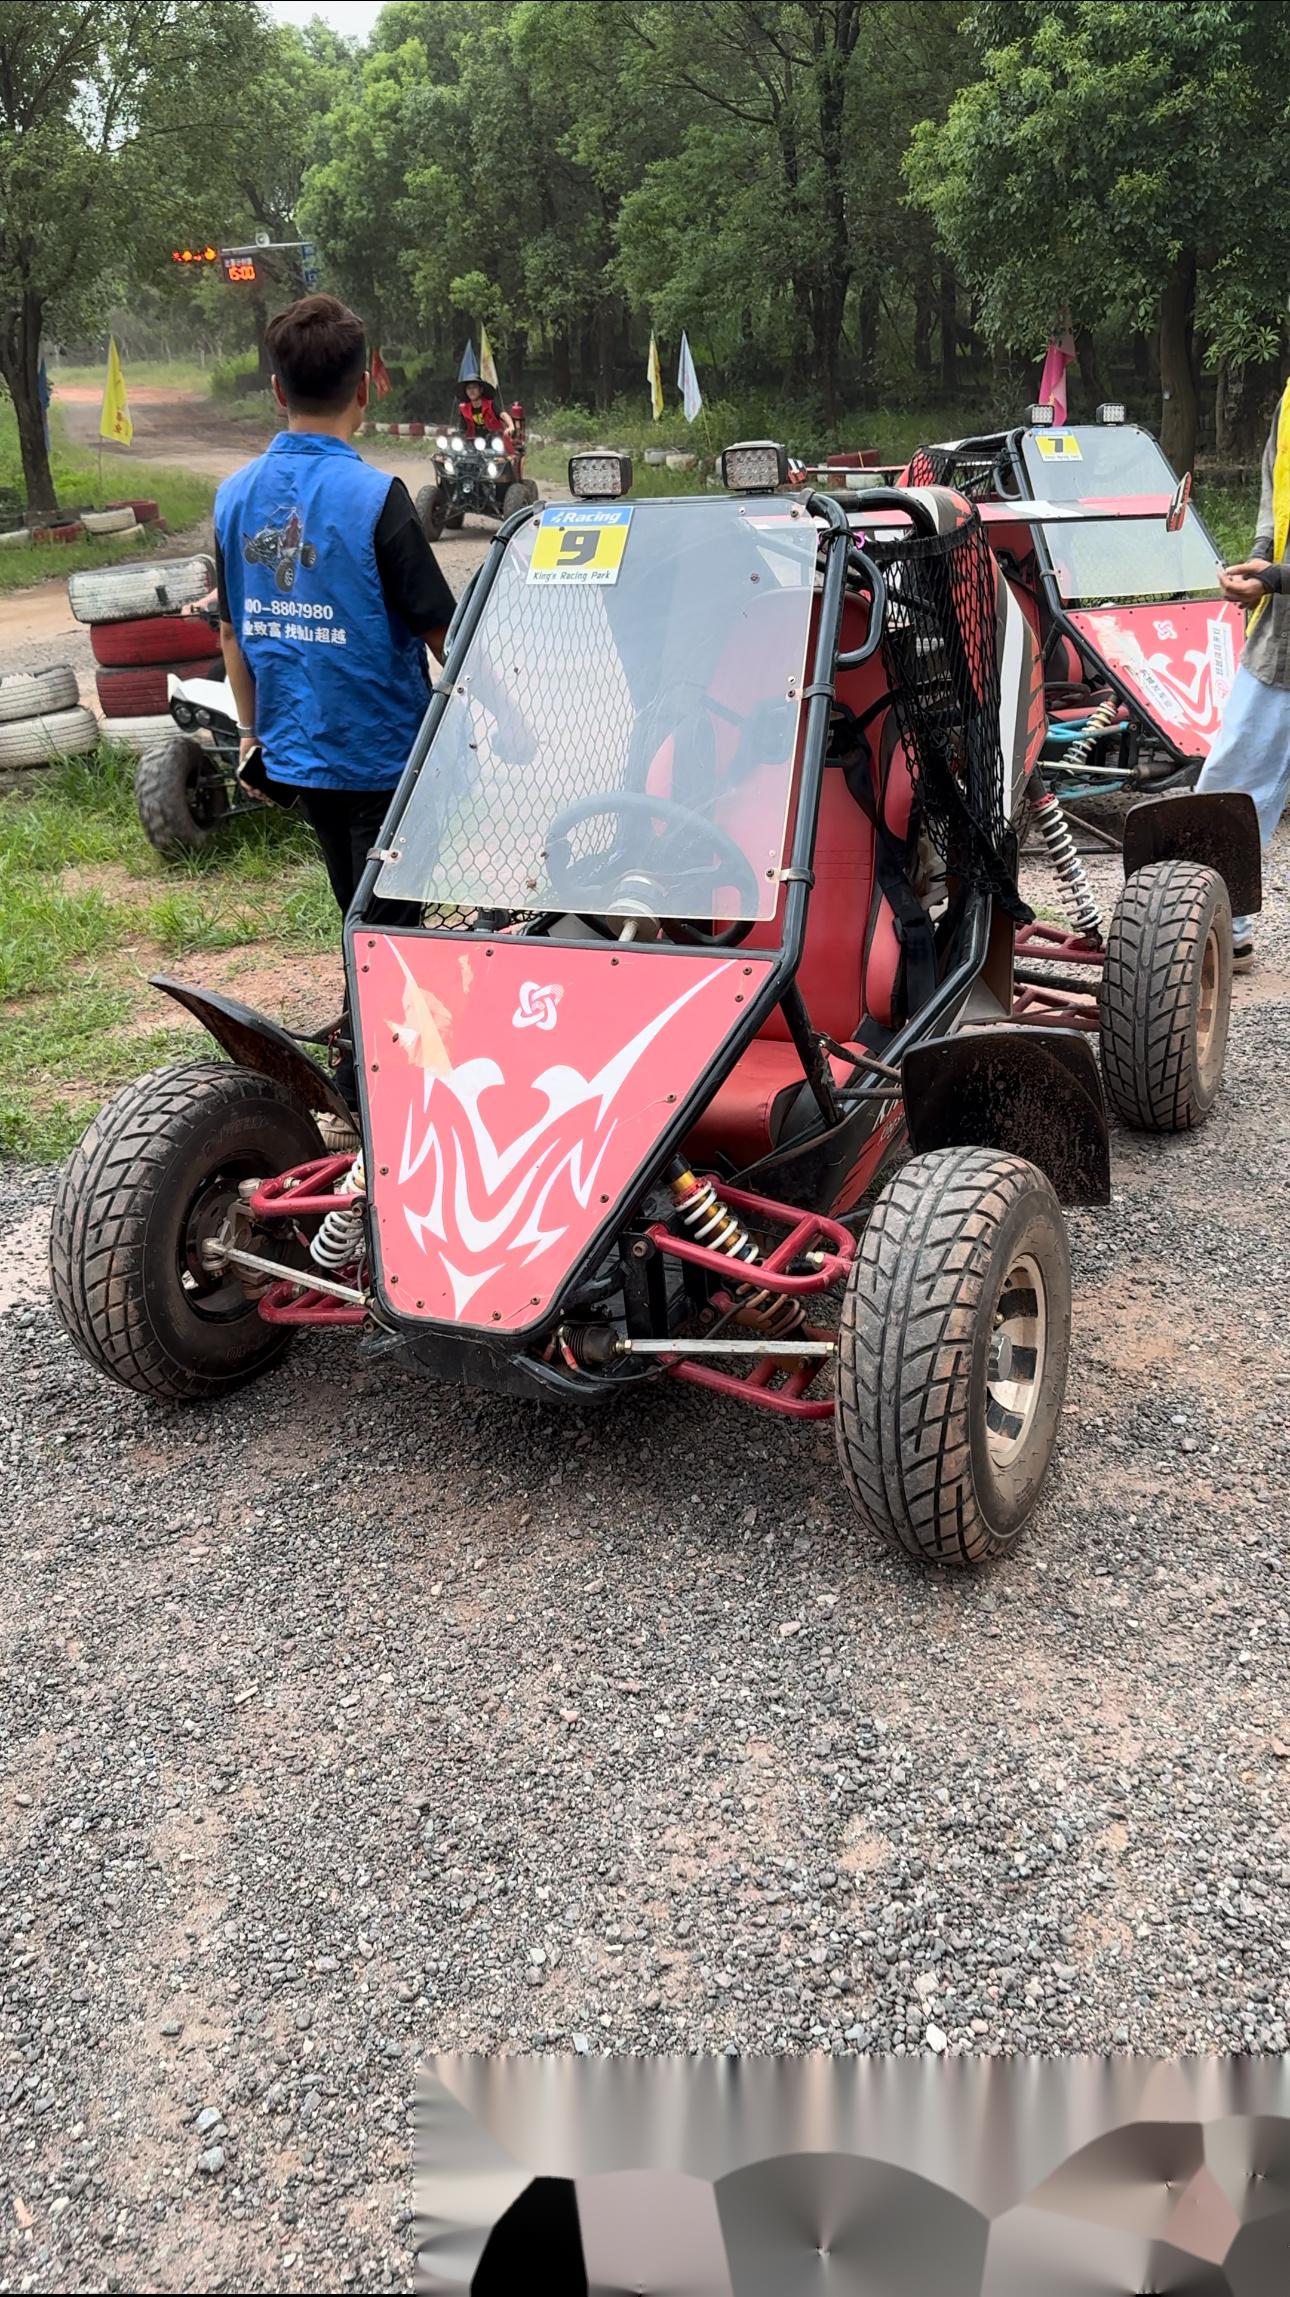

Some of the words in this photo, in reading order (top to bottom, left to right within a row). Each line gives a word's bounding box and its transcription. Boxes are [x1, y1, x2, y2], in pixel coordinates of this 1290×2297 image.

[556, 530, 601, 566] 9
[560, 571, 588, 582] Racing
[591, 570, 610, 580] Park
